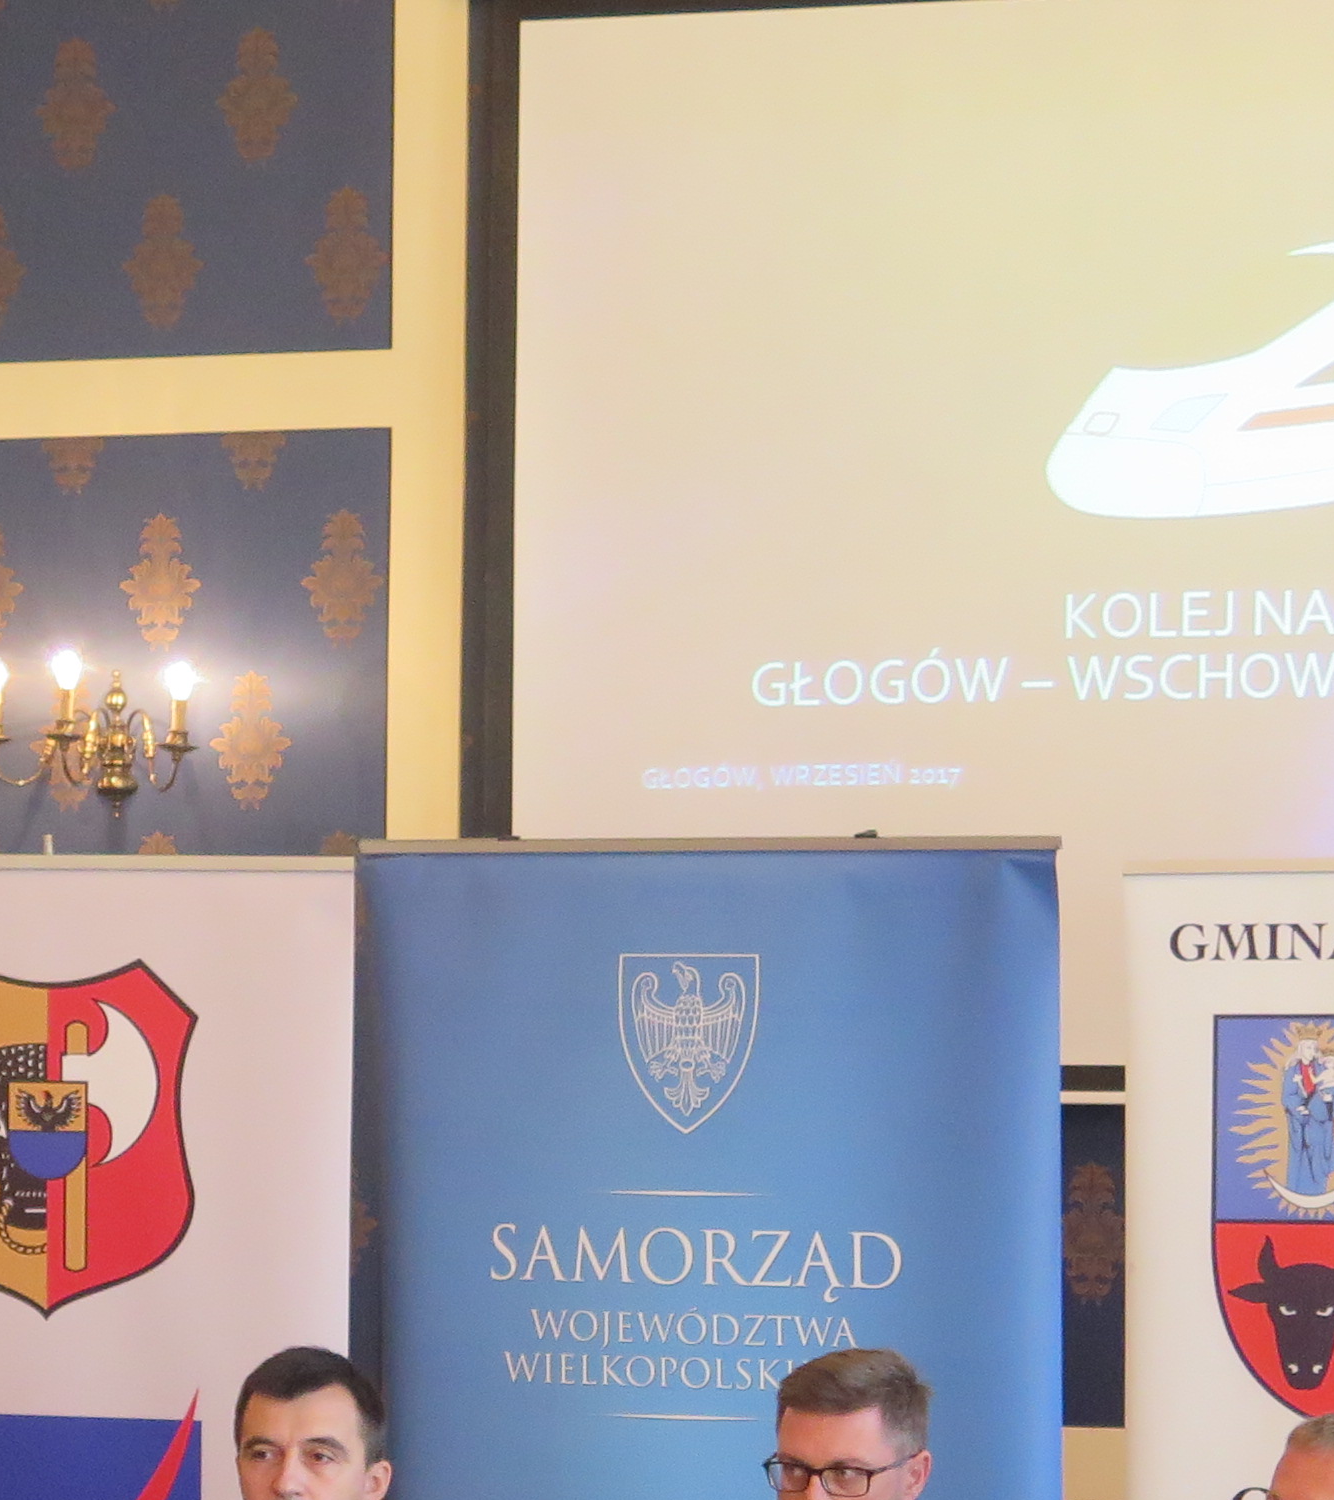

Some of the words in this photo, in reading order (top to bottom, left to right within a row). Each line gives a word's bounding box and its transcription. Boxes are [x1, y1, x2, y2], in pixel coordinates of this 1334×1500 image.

[1064, 590, 1235, 639] KOLEJ
[751, 646, 1010, 707] GŁOGÓW
[641, 763, 764, 790] GŁOGÓW,
[769, 758, 903, 787] WRZESIEŃ
[908, 765, 964, 790] 2017
[489, 1222, 904, 1304] SAMORZĄD
[529, 1306, 859, 1349] WOJEWÓDZTWA
[503, 1350, 795, 1392] WIELKOPOLSK
